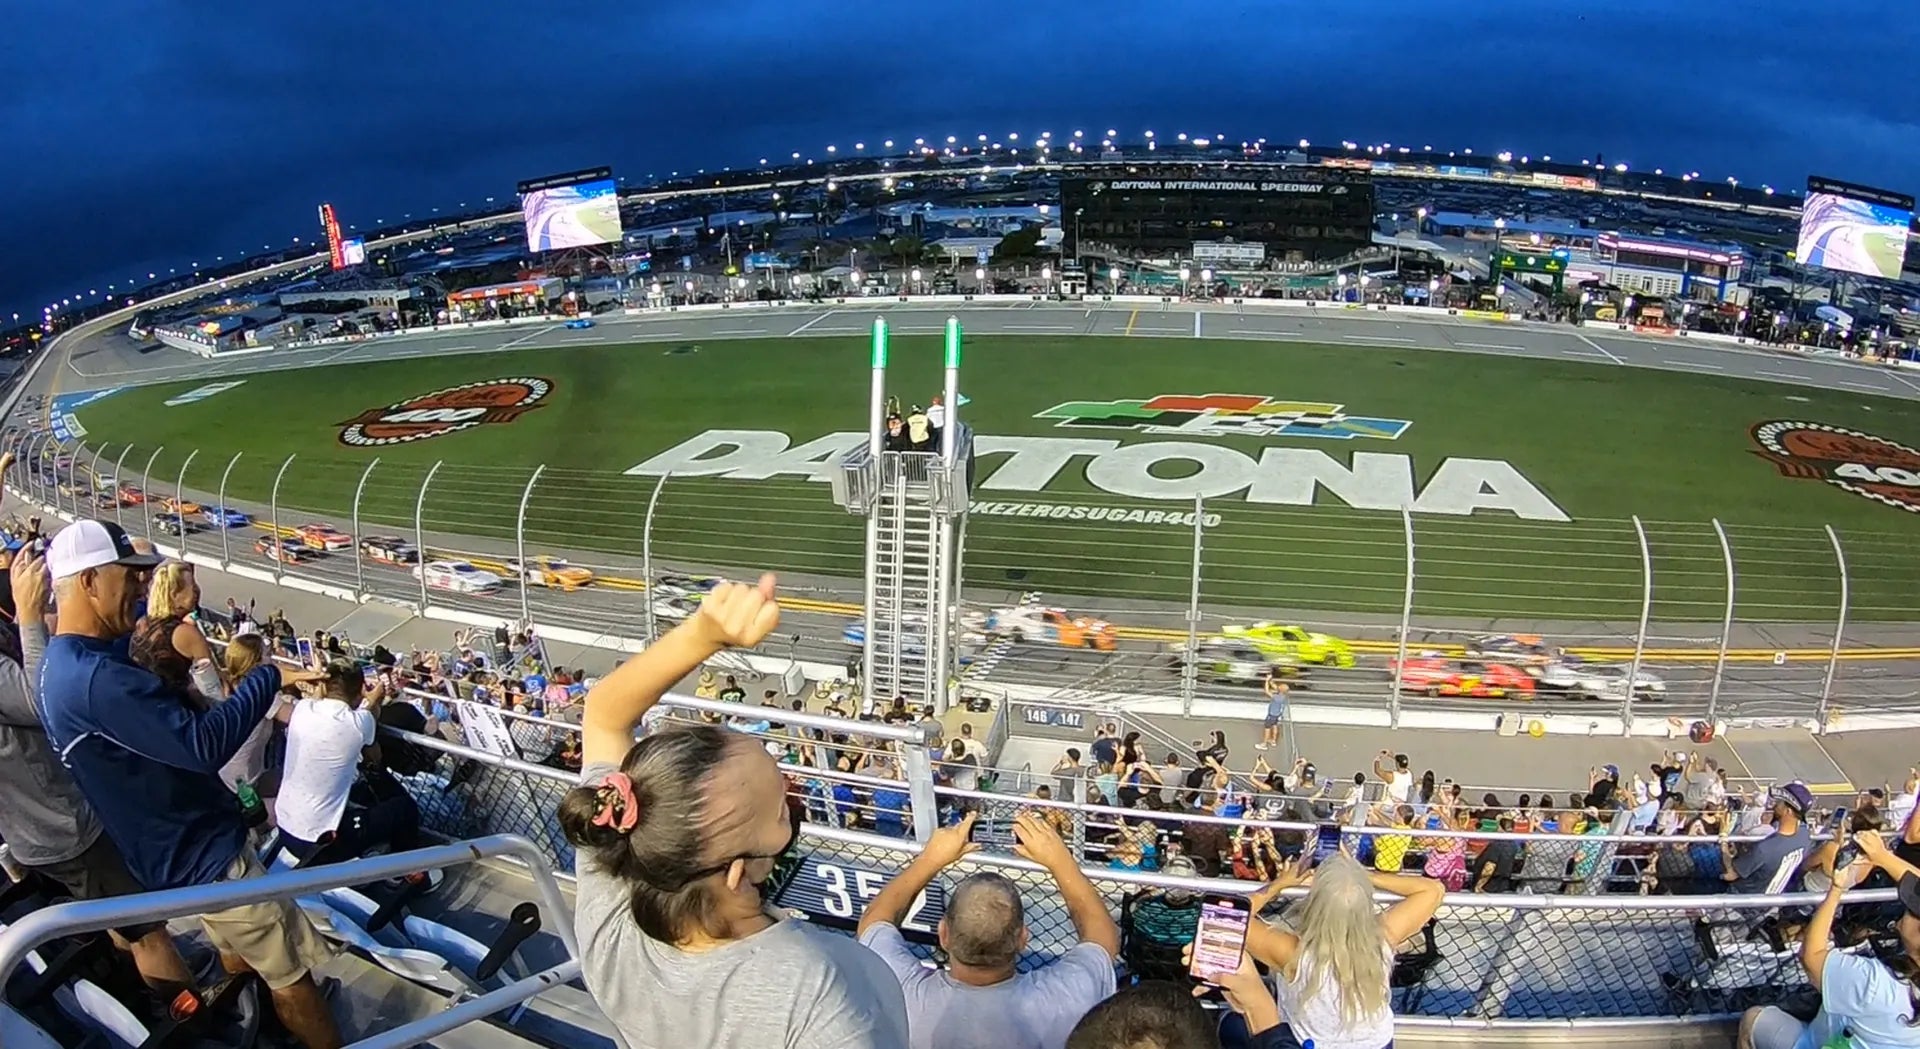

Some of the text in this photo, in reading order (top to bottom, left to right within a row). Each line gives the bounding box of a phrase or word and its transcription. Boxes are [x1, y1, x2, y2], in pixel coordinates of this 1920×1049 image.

[1111, 181, 1324, 193] DAYTONA INTERNATIONAL SPEEDWAY
[379, 407, 488, 422] 400
[622, 429, 1572, 521] DATONA
[1834, 462, 1920, 487] 40
[1026, 709, 1081, 726] 146 147
